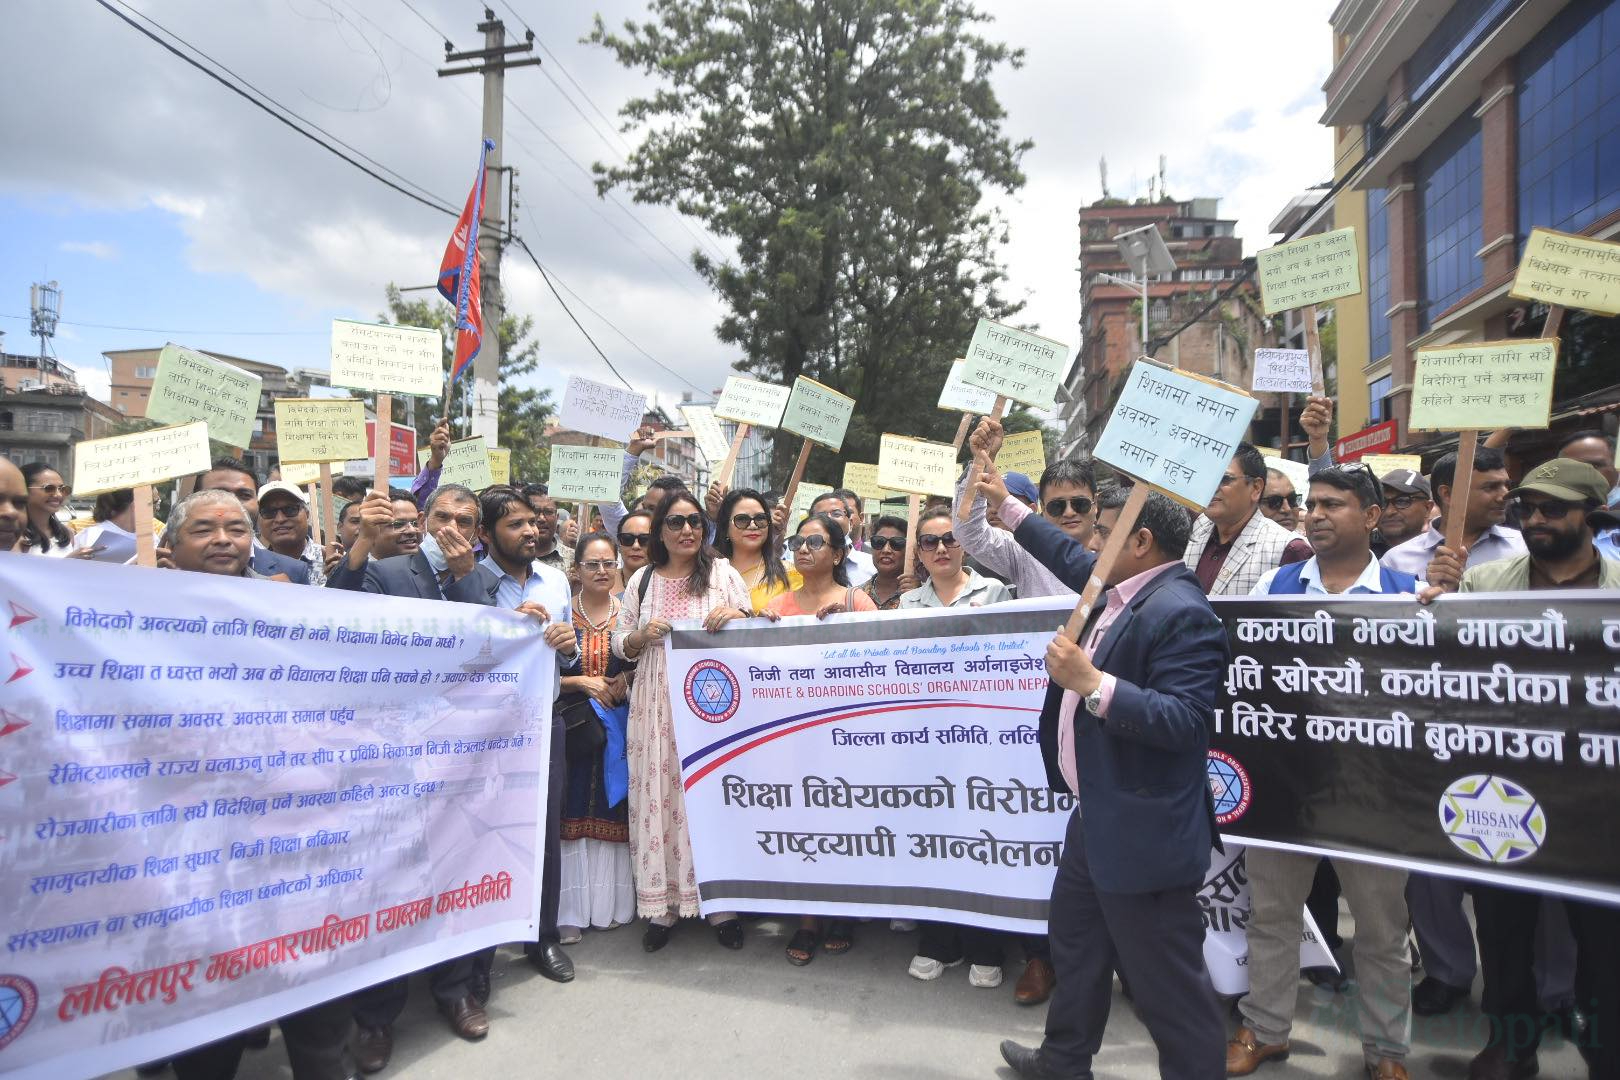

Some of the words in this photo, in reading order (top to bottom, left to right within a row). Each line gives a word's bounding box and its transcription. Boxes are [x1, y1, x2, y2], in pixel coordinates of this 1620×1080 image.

[1501, 372, 1544, 382] अवस्था
[1137, 371, 1191, 405] शिक्षामा
[1197, 395, 1240, 422] समान
[1117, 403, 1160, 435] अवसर,
[1168, 424, 1232, 459] अवसरमा
[1120, 440, 1159, 467] समान
[65, 606, 134, 630] विभेदको
[139, 616, 207, 634] अन्त्यको
[212, 618, 248, 637] लागि
[253, 620, 287, 639] शिक्षा
[290, 624, 304, 641] हो
[337, 626, 378, 645] शिक्षामा
[381, 629, 407, 647] विभेद
[411, 632, 433, 648] किन
[1236, 609, 1336, 646] कम्पनी
[864, 648, 890, 657] Private
[893, 646, 908, 656] and
[911, 644, 947, 656] Boarding
[950, 642, 980, 653] Schools
[983, 642, 996, 651] Be
[55, 662, 96, 680] उच्च
[100, 659, 146, 680] शिक्षा
[150, 665, 162, 680] त
[167, 665, 202, 681] ध्वस्त
[208, 663, 239, 681] भयो
[242, 667, 266, 681] अब
[269, 664, 284, 680] के
[287, 665, 336, 683] विद्यालय
[339, 666, 367, 684] शिक्षा
[371, 668, 392, 683] पनि
[394, 669, 419, 684] सक्ने
[421, 668, 433, 684] हो
[441, 672, 468, 684] जवाफ
[488, 672, 519, 683] सरकार
[749, 665, 782, 682] निजी
[788, 666, 815, 682] तथा
[824, 662, 887, 681] आवासीय
[895, 659, 954, 679] विद्यालय
[752, 686, 793, 699] PRIVATE
[796, 686, 805, 699] &
[807, 684, 865, 699] BOARDING
[927, 680, 1014, 695] ORGANIZATION
[1017, 678, 1049, 691] NEPA
[1380, 662, 1571, 706] कर्मचारीका
[56, 709, 116, 731] शिक्षामा
[122, 713, 174, 729] समान
[233, 711, 288, 727] अवसरमा
[292, 709, 326, 723] समान
[832, 728, 885, 746] जिल्ला
[891, 726, 929, 745] कार्य
[935, 725, 992, 746] समिति,
[999, 724, 1040, 745] ललि
[1232, 701, 1297, 741] तिरेर
[1305, 712, 1415, 750] कम्पनी
[1424, 721, 1566, 762] बुझाउन
[158, 760, 202, 776] राज्य
[291, 753, 306, 767] तर
[312, 748, 333, 764] सीप
[339, 749, 345, 763] र
[350, 744, 380, 763] प्रविधि
[383, 743, 423, 760] सिकाउन
[426, 740, 451, 756] निजी
[721, 774, 793, 811] शिक्षा
[802, 775, 956, 809] विधेयकको
[1227, 757, 1250, 801] ORGANIZATION
[35, 812, 137, 839] रोजगारीका
[141, 804, 177, 828] लागि
[214, 797, 268, 817] विदेशिनु
[297, 791, 337, 808] अवस्था
[340, 784, 374, 802] कहिले
[379, 784, 410, 798] अन्त्य
[414, 781, 437, 798] हुन्छ
[1466, 809, 1519, 830] HISSAN
[756, 826, 897, 863] राष्ट्रव्यापी
[907, 829, 1063, 867] आन्दोलन
[30, 862, 139, 895] सामुदायीक
[144, 855, 179, 878] शिक्षा
[230, 839, 265, 860] निजी
[269, 836, 301, 854] शिक्षा
[7, 920, 101, 952] संस्थागत
[106, 914, 128, 932] वा
[132, 896, 216, 929] सामुदायीक
[219, 888, 254, 909] शिक्षा
[258, 873, 311, 901] छनोटको
[317, 866, 365, 888] अधिकार
[56, 958, 201, 1023] ललितपुर
[205, 913, 371, 983] महानगरपालिका
[436, 870, 513, 916] कार्यसमिति
